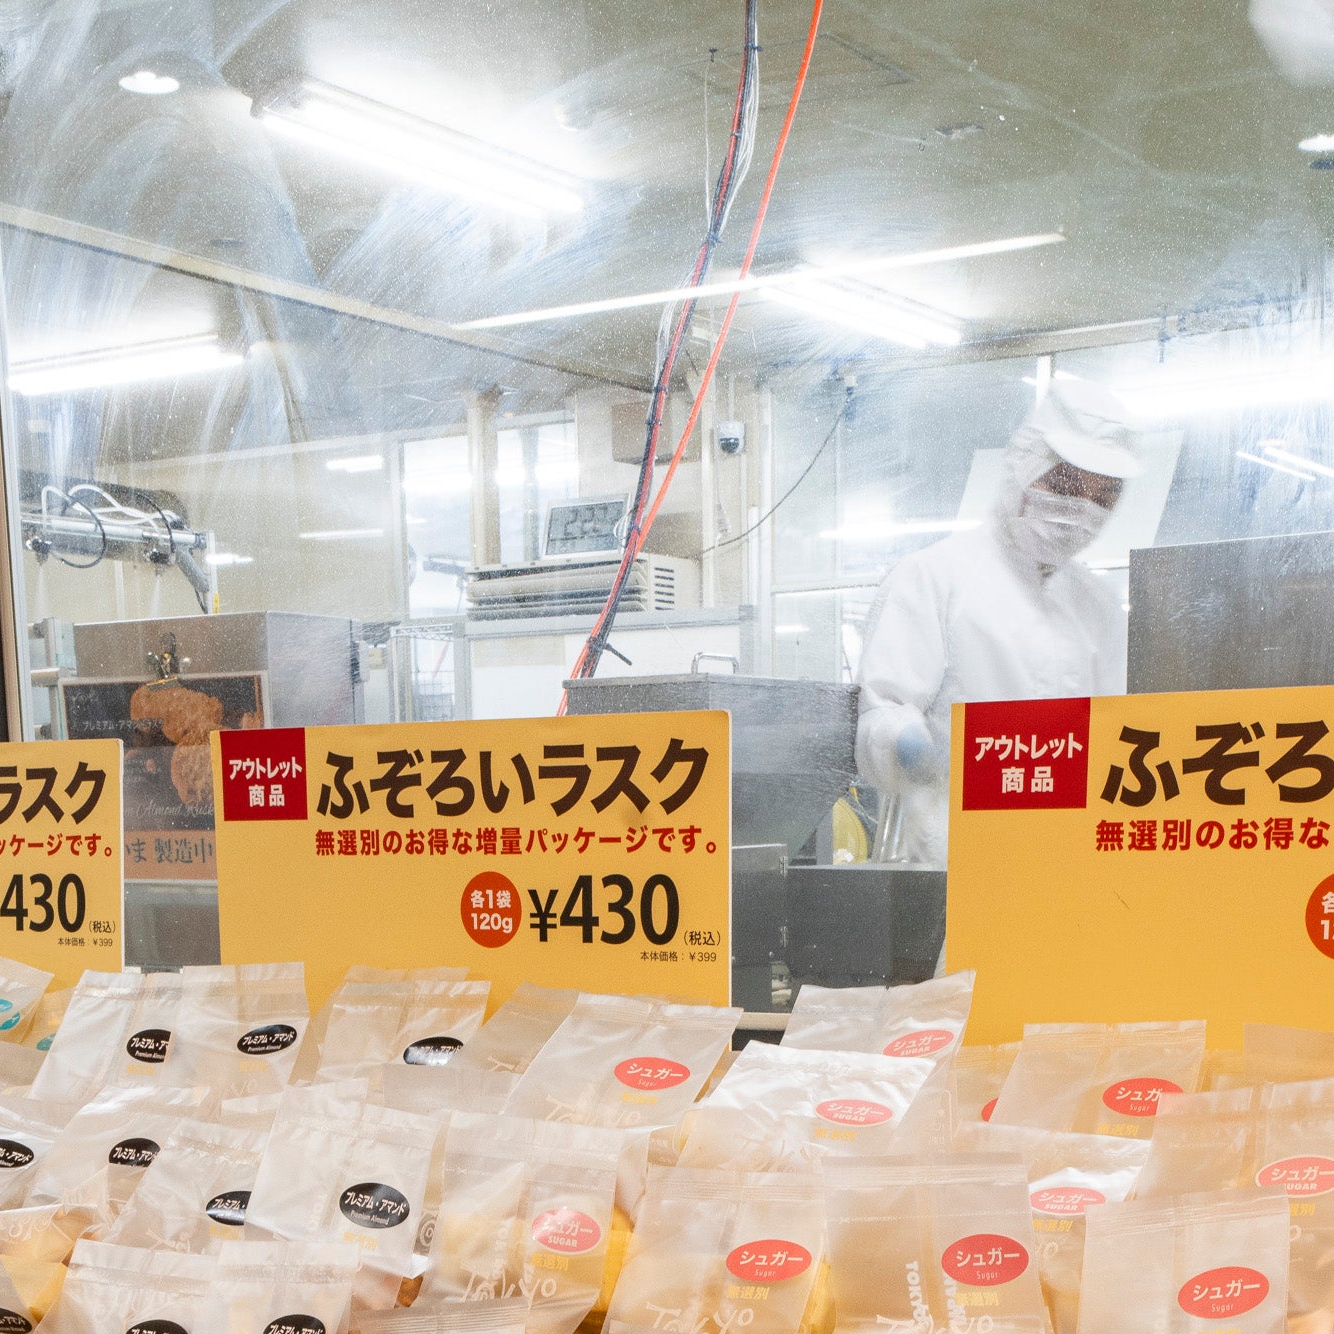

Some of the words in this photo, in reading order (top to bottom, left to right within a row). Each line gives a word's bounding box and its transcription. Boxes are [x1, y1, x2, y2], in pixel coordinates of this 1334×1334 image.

[974, 732, 1083, 761] アウトレット
[229, 756, 303, 781] アウトレット
[316, 738, 709, 820] ふぞろいラスク
[1001, 767, 1055, 794] 商品
[248, 784, 285, 807] 商品
[315, 825, 716, 857] 無選別のお得な増量パッケージです。
[471, 889, 511, 909] 各1袋
[528, 873, 680, 946] ¥430
[684, 931, 721, 946] (税込)
[89, 920, 115, 934] (税込)
[471, 913, 513, 934] 120g
[893, 1034, 947, 1051] シュガー
[625, 1062, 684, 1082] シュガー
[738, 1250, 804, 1268] シュガー
[955, 1247, 1020, 1268] シュガー
[1192, 1279, 1260, 1301] シュガー
